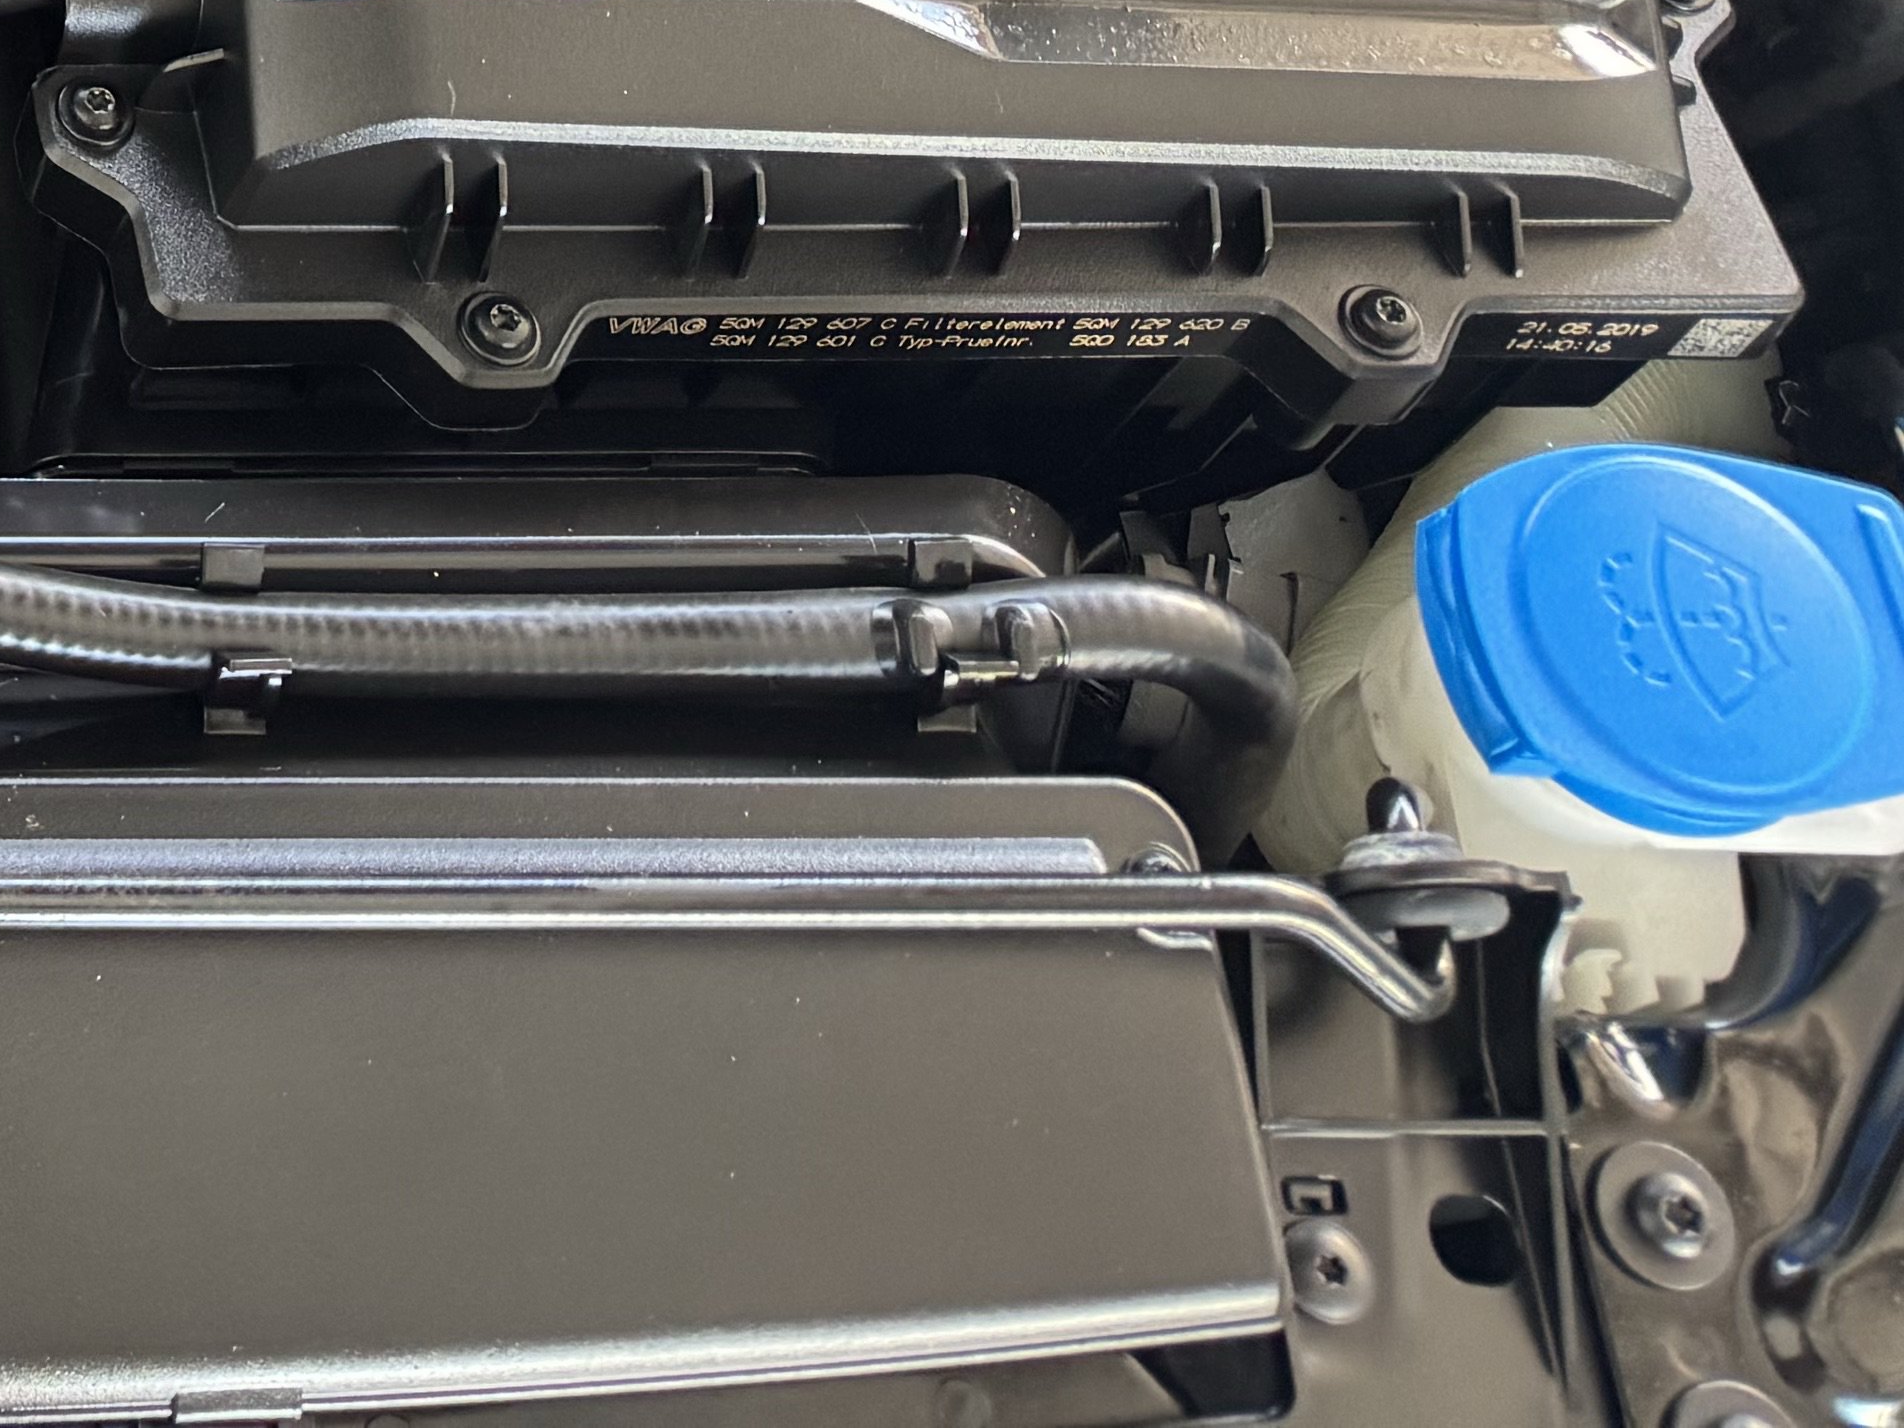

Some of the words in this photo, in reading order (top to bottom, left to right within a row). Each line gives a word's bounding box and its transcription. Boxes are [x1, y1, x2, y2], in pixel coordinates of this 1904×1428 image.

[718, 318, 765, 330] 5QM
[776, 317, 820, 330] 129
[826, 317, 867, 330] 607
[880, 318, 897, 329] C
[903, 317, 1064, 331] Filterelement
[1129, 318, 1171, 331] 129
[1178, 318, 1224, 331] 620
[1230, 318, 1251, 331] B
[711, 335, 754, 347] 5QM
[767, 335, 808, 347] 129
[815, 335, 856, 346] 601
[1126, 334, 1169, 347] 183
[1173, 334, 1190, 347] A
[1506, 338, 1612, 353] 14:40:16
